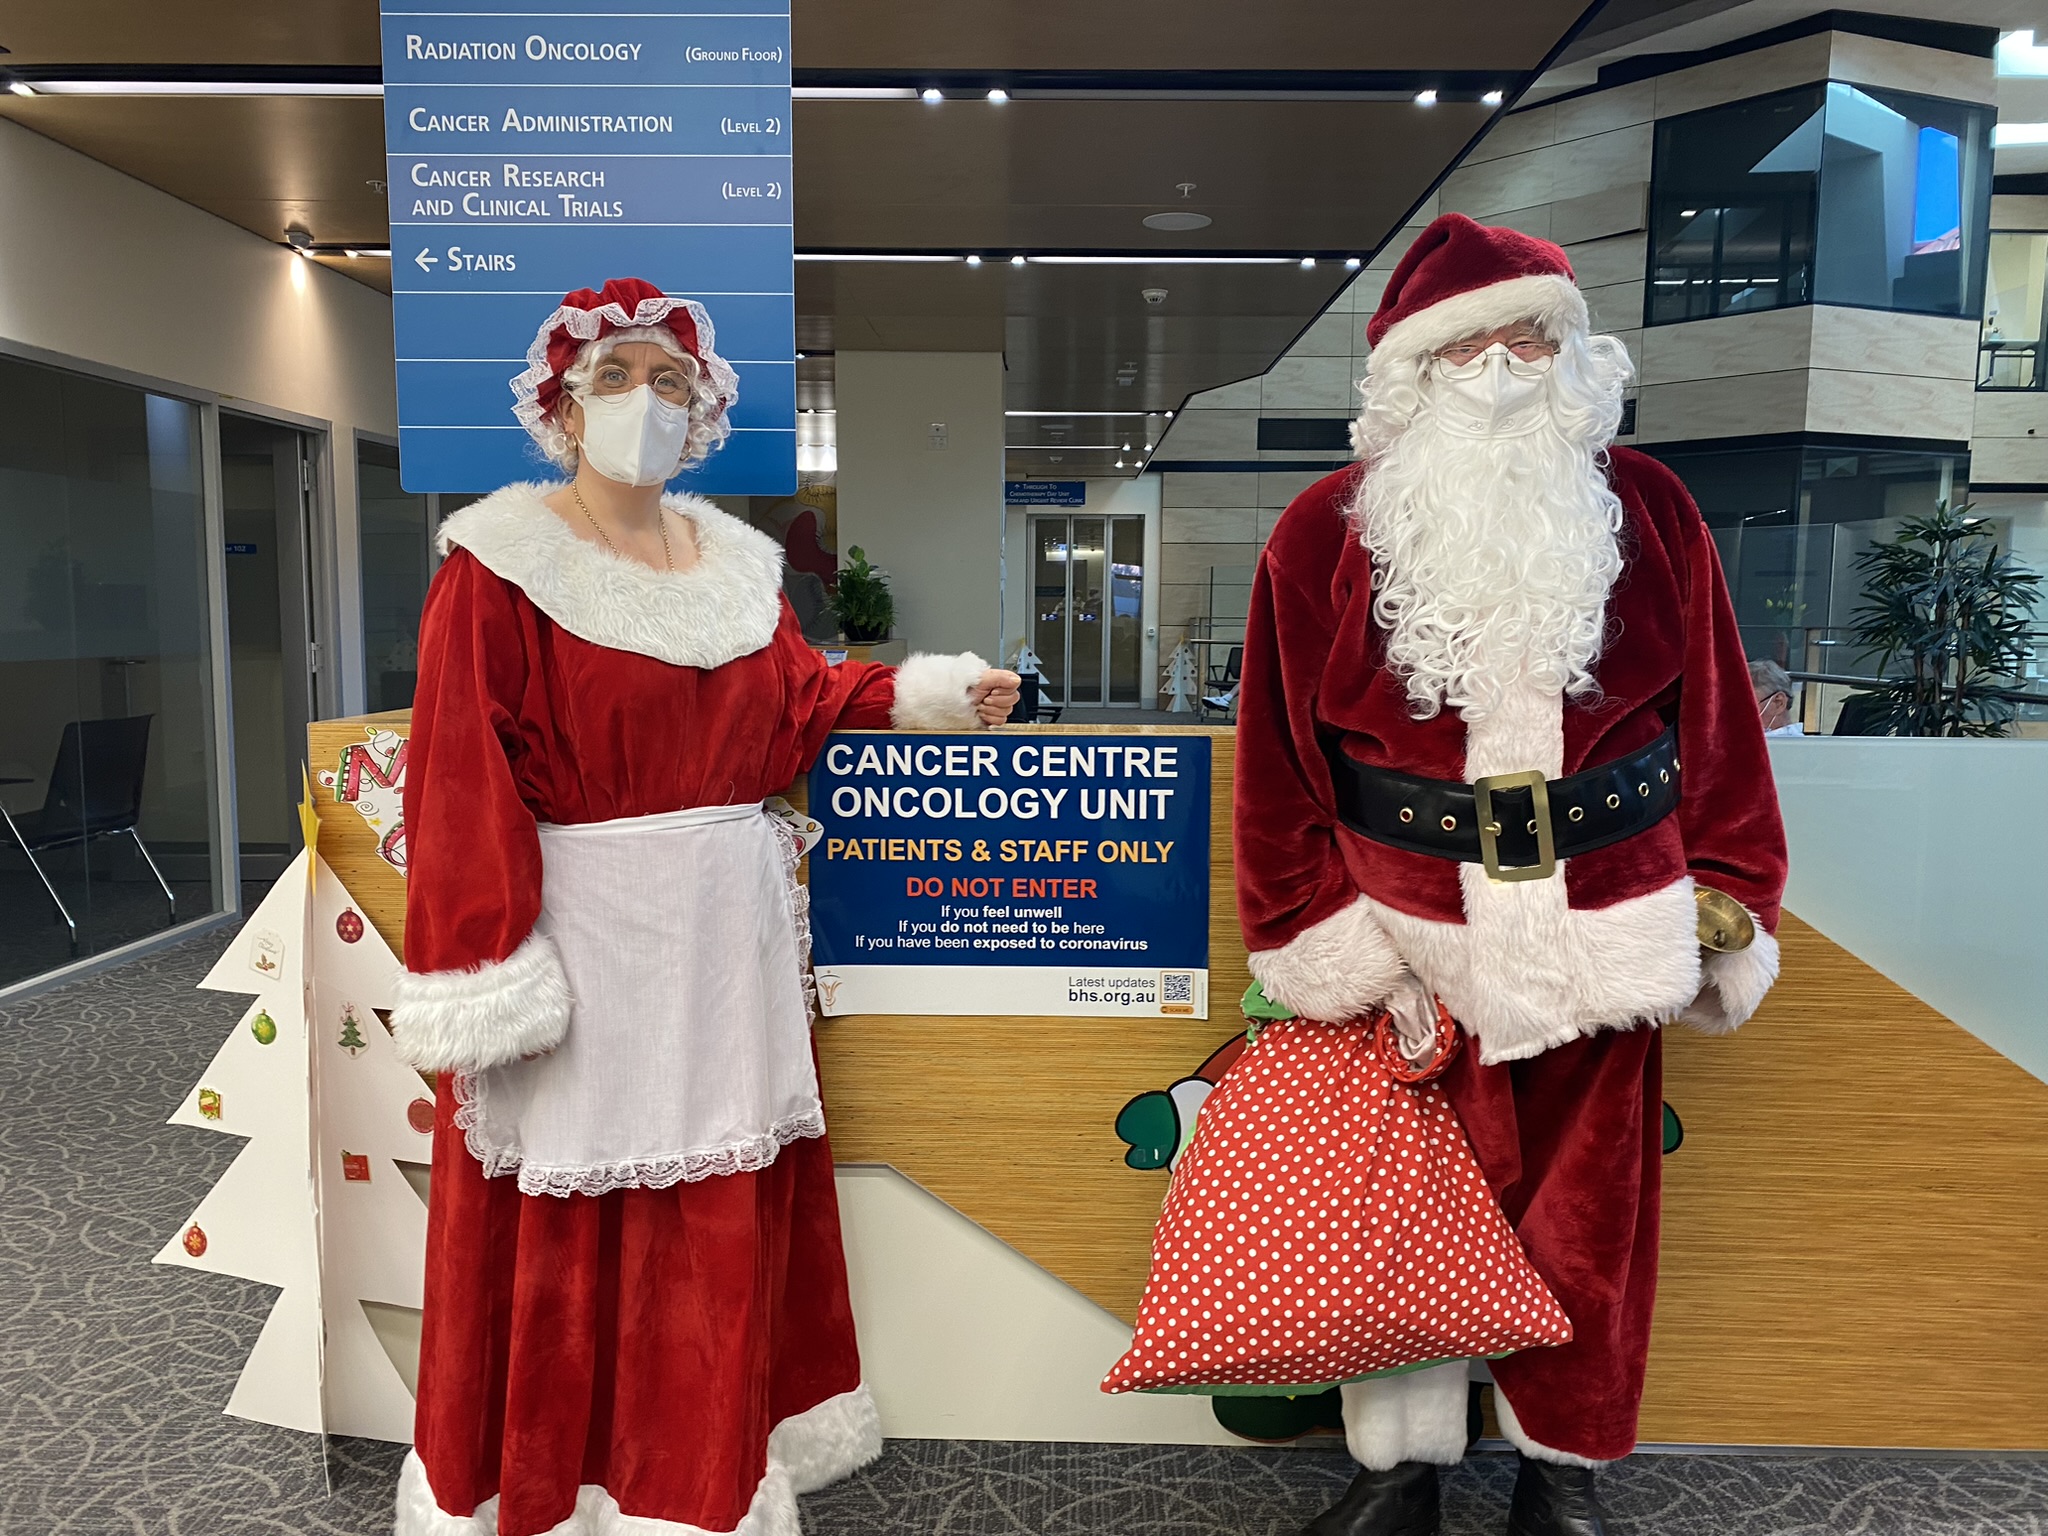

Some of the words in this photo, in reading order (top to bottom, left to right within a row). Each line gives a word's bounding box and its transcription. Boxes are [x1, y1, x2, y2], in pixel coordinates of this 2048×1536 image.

[406, 34, 516, 60] RADIATION
[525, 35, 642, 61] ONCOLOGY
[409, 107, 490, 132] CANCER
[501, 108, 673, 133] ADMINISTRATION
[765, 117, 781, 135] 2)
[411, 163, 492, 187] CANCER
[503, 163, 605, 188] RESEARCH
[766, 181, 782, 200] 2)
[411, 198, 454, 216] AND
[462, 193, 551, 217] CLINICAL
[557, 194, 623, 218] TRIALS
[447, 246, 516, 272] STAIRS
[826, 744, 1000, 777] CANCER
[1012, 745, 1179, 778] CENTRE
[831, 786, 1069, 819] ONCOLOGY
[1080, 788, 1175, 820] UNIT
[827, 838, 963, 862] PATIENTS
[971, 839, 992, 862] &
[999, 839, 1089, 863] STAFF
[1097, 840, 1175, 863] ONLY
[906, 876, 944, 898] DO
[951, 877, 1005, 898] NOT
[1012, 878, 1098, 899] ENTER
[941, 905, 950, 918] If
[953, 908, 979, 921] you
[983, 905, 1010, 918] feel
[1014, 906, 1062, 919] unwell
[899, 920, 908, 933] If
[911, 923, 936, 936] you
[940, 920, 959, 933] do
[963, 921, 988, 934] not
[992, 921, 1028, 934] need
[1032, 921, 1048, 934] to
[1051, 921, 1070, 934] be
[1073, 921, 1105, 935] here
[855, 935, 865, 948] If
[867, 938, 893, 951] you
[897, 935, 931, 949] have
[935, 936, 970, 949] been
[973, 936, 1037, 952] exposed
[1040, 937, 1055, 950] to
[1059, 937, 1149, 951] coronavirus
[1068, 976, 1105, 987] Latest
[1108, 977, 1156, 990] updates
[1068, 988, 1156, 1006] bhs.org.au
